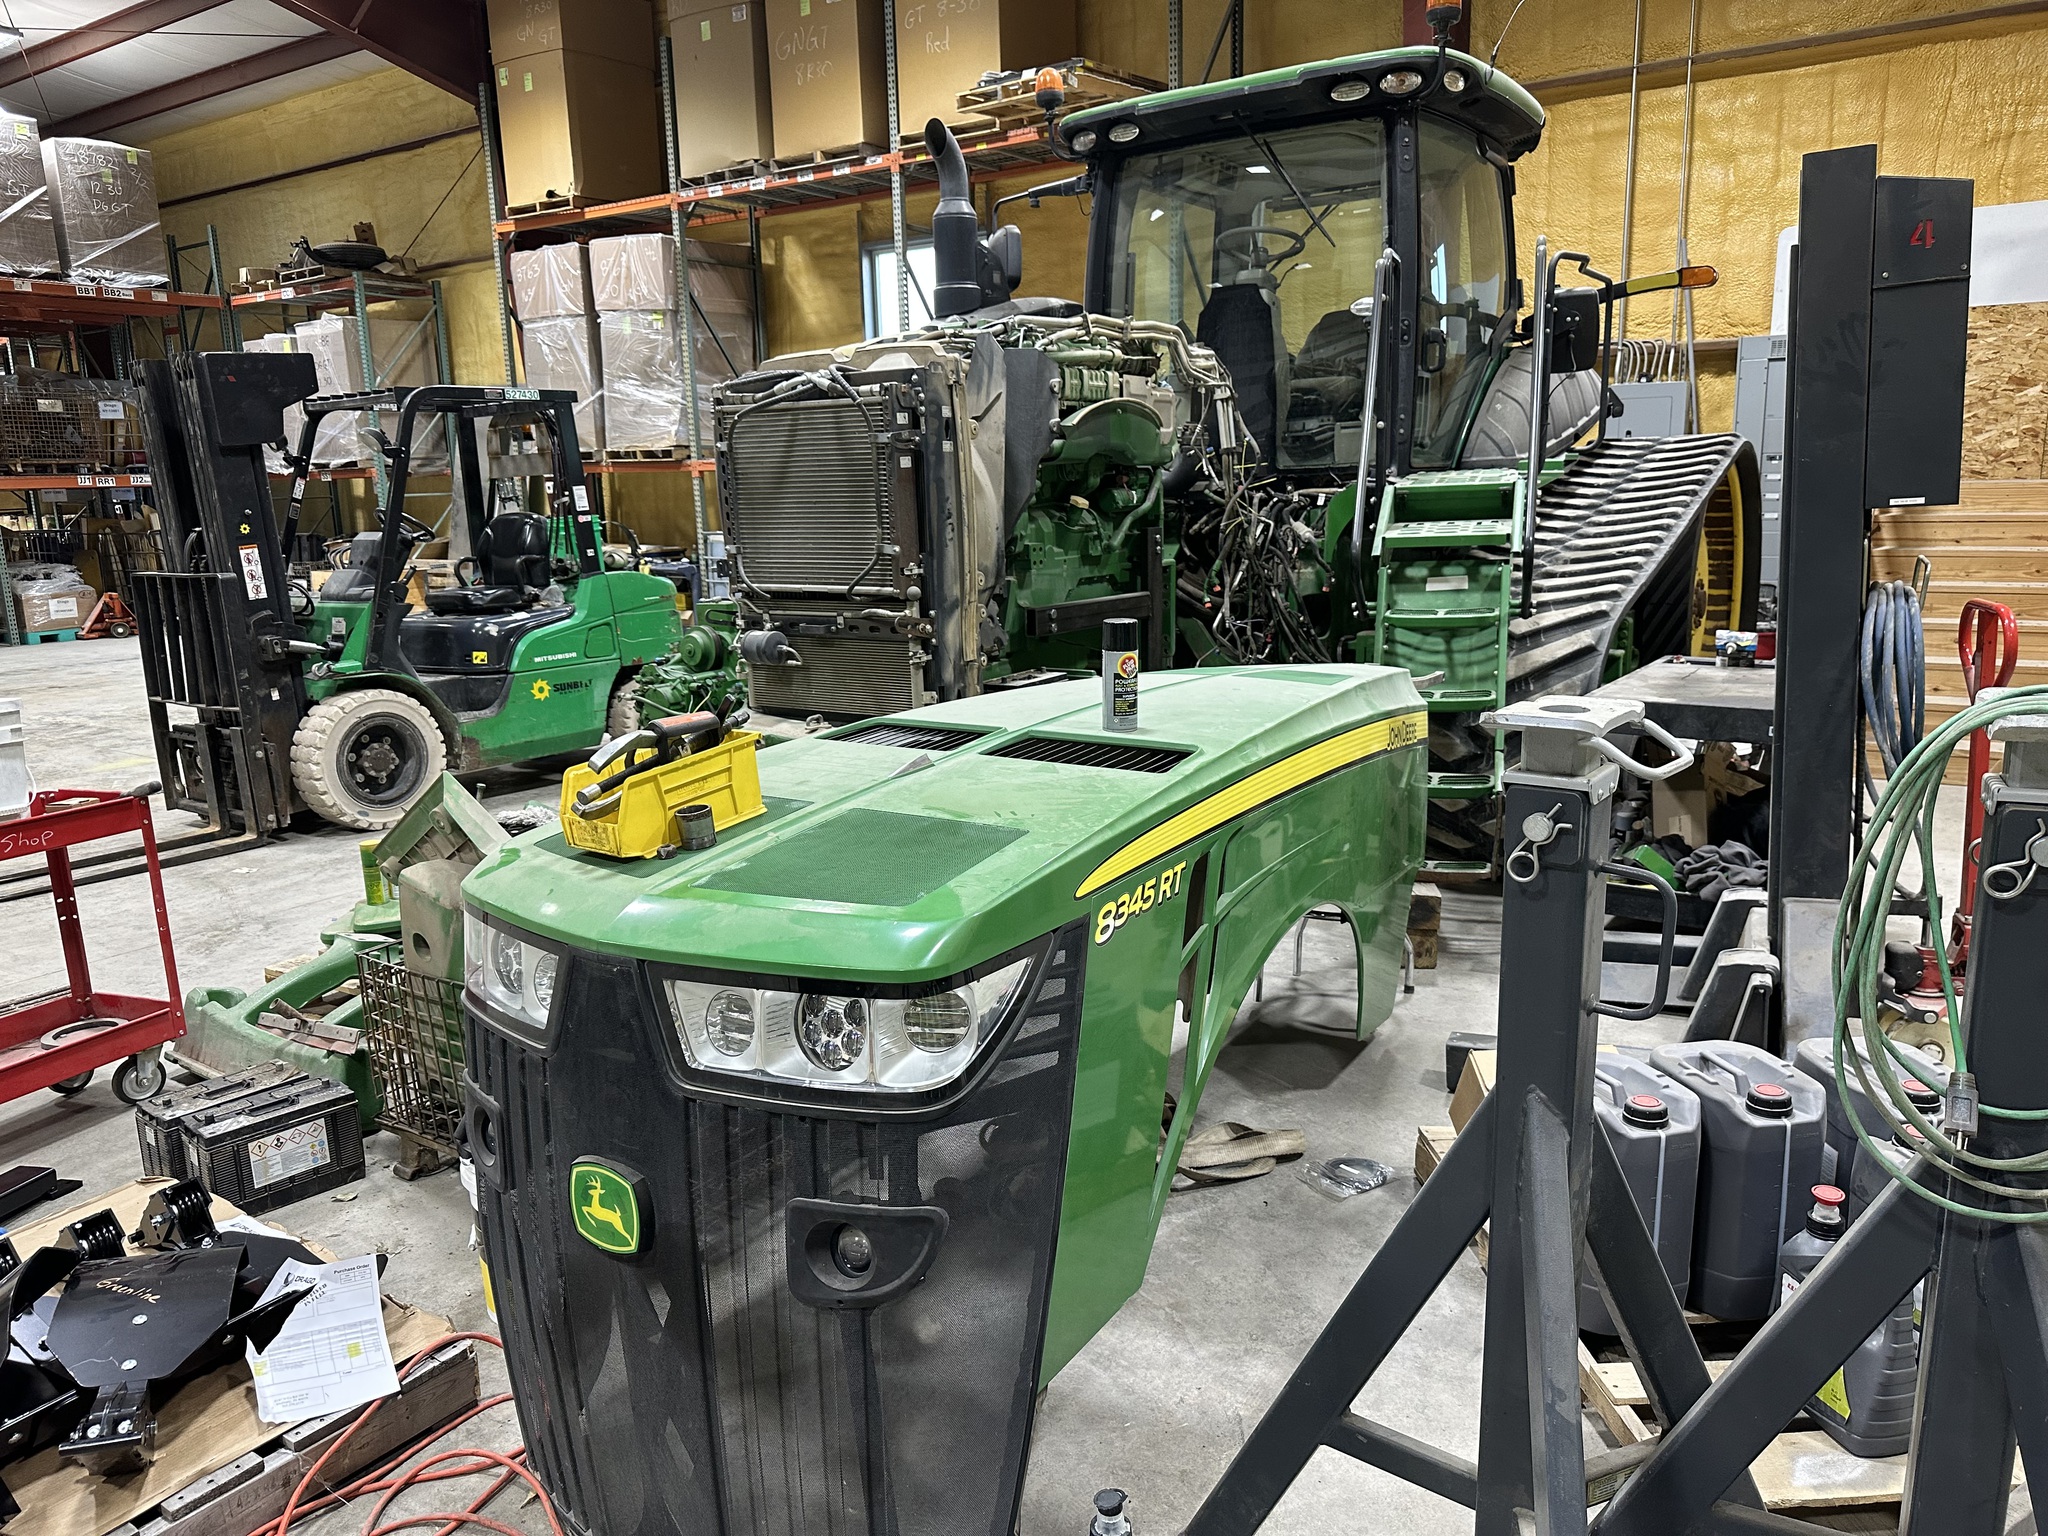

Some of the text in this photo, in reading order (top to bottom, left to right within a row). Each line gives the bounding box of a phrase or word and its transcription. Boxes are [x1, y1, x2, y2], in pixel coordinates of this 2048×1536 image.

[904, 5, 926, 29] GT
[516, 21, 557, 46] GN GT
[926, 26, 951, 54] Red
[1909, 218, 1936, 248] 4
[77, 286, 95, 296] BB1
[104, 288, 121, 298] BB2
[506, 389, 539, 400] 527430
[97, 478, 115, 486] RR1
[132, 476, 143, 484] JJ2
[534, 652, 577, 663] MITSUBISHI
[1094, 860, 1188, 947] 8345 RT
[333, 1266, 356, 1275] Purchase
[294, 1275, 316, 1285] DRAGO
